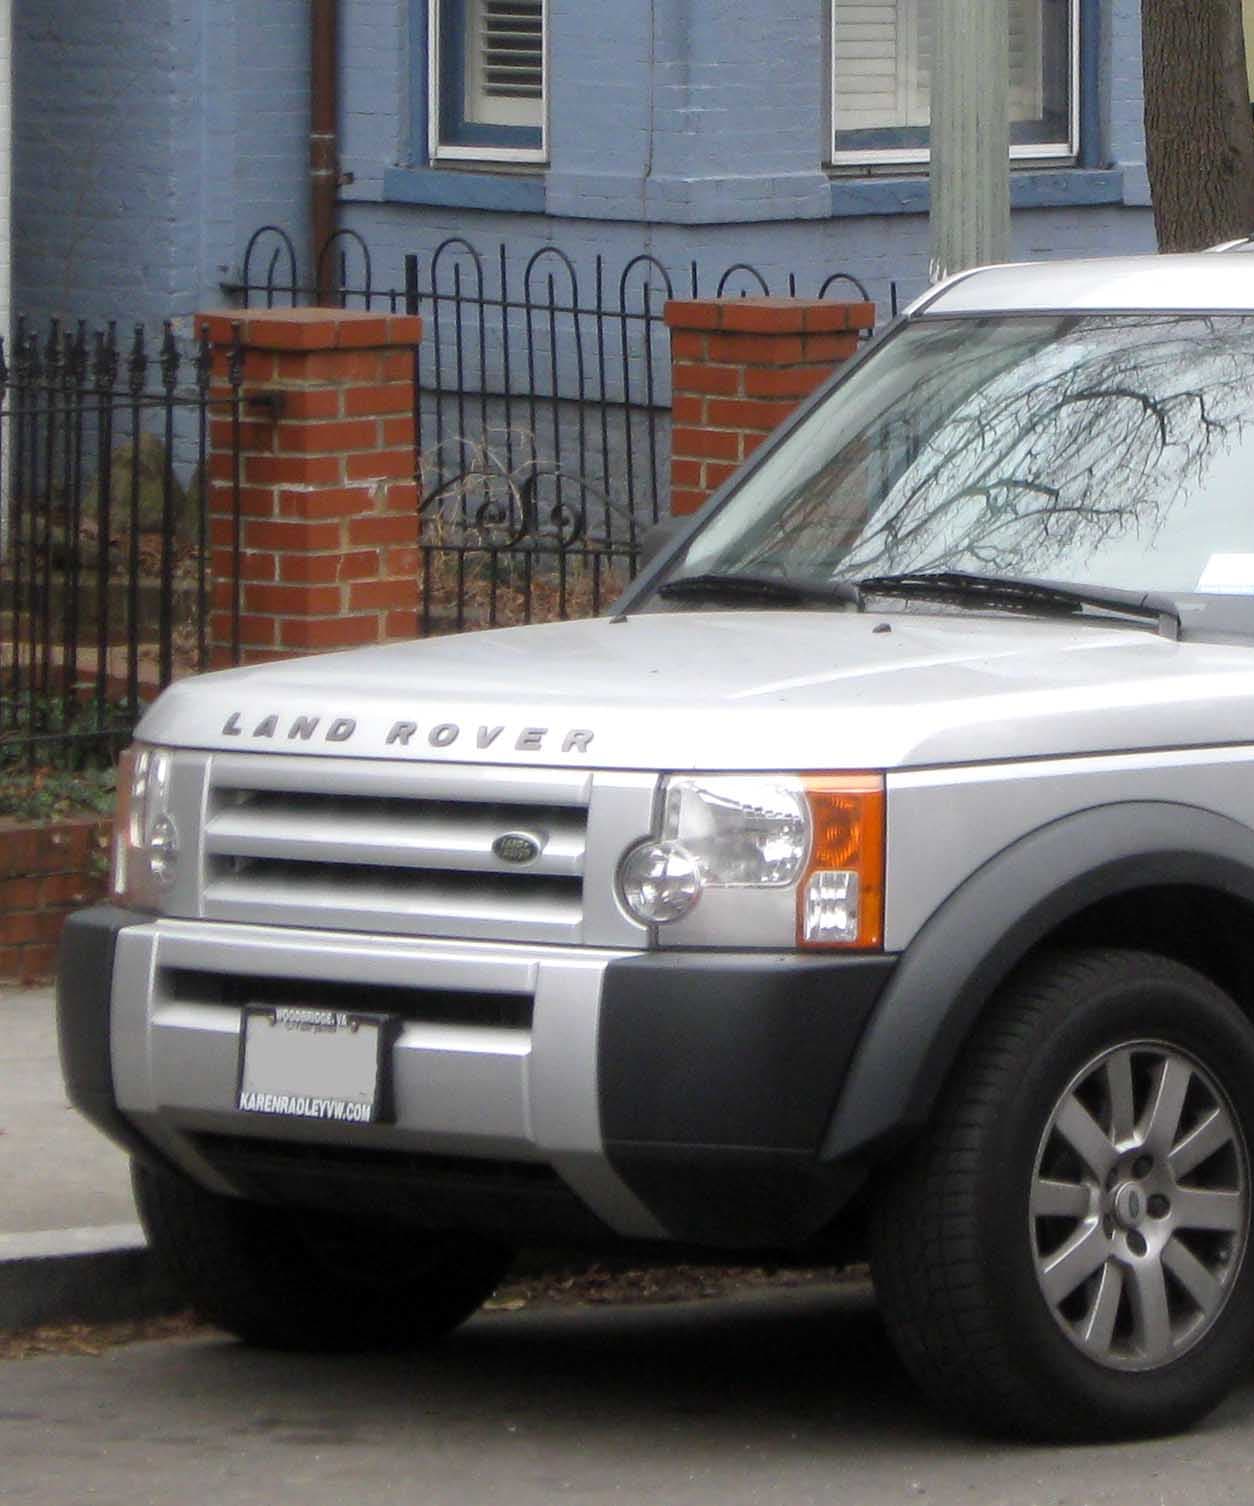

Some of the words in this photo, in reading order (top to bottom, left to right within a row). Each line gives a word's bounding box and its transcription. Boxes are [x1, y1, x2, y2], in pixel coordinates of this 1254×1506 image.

[222, 712, 356, 742] LAND
[385, 720, 594, 753] ROVER
[336, 1013, 347, 1026] VA
[239, 1092, 371, 1122] KARENRADLEYVW.COM
